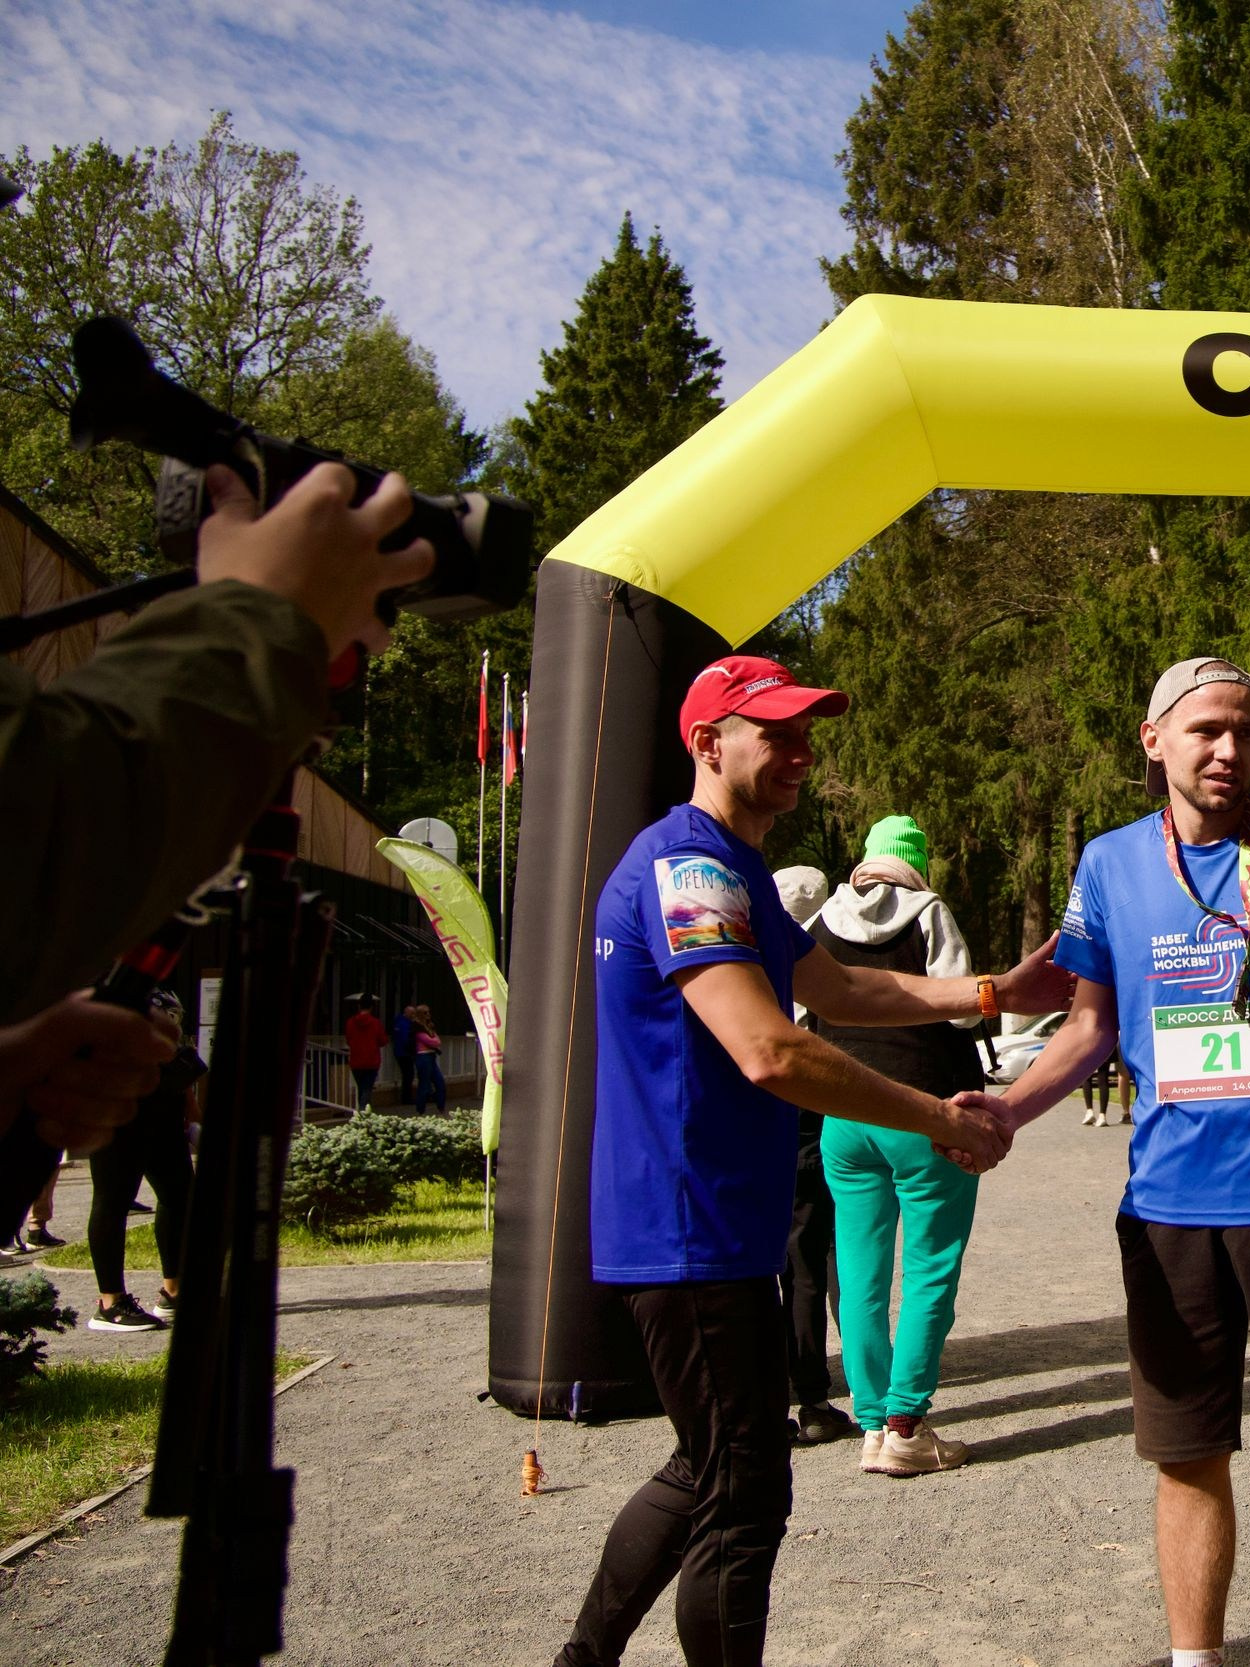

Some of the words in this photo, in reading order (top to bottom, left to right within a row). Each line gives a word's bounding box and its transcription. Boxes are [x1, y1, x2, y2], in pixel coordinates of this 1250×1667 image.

[673, 869, 714, 890] OPEN
[1151, 933, 1189, 946] ЗАБЕГ
[1154, 956, 1210, 971] МОСКВЫ
[1167, 1011, 1219, 1025] КРОСС
[1201, 1031, 1241, 1072] 21
[1171, 1085, 1224, 1095] Апрелевка
